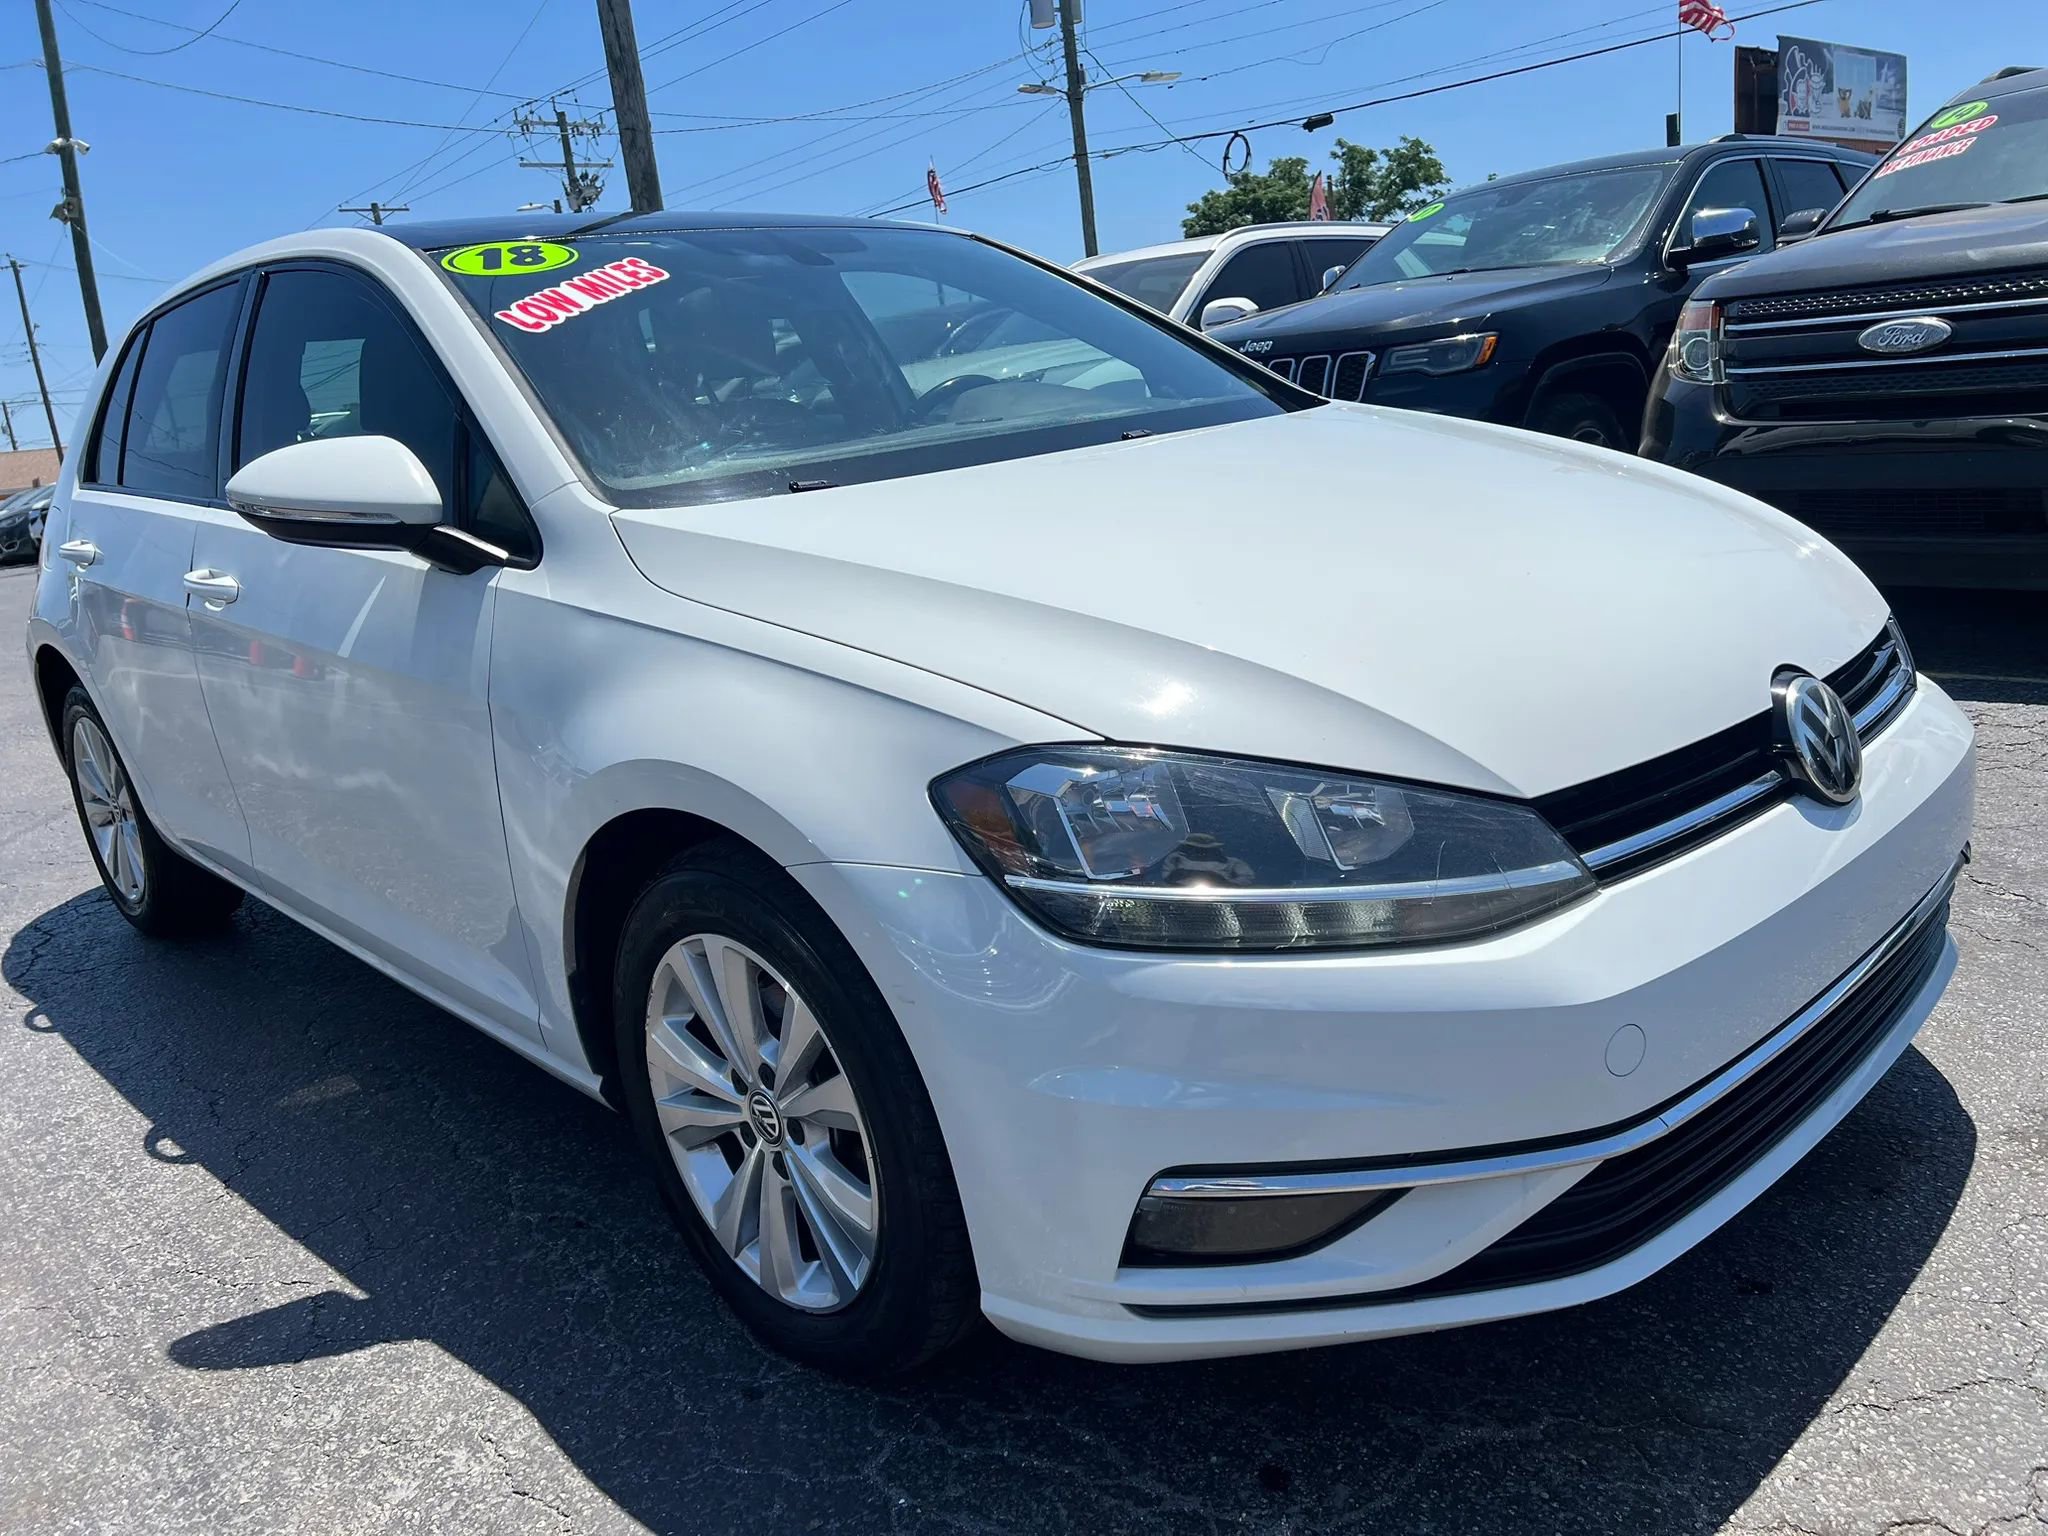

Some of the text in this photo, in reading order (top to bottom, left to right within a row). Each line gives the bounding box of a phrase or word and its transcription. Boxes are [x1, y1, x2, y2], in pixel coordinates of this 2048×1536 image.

[1898, 115, 1997, 155] LOADED
[1901, 137, 1976, 168] FINANCE
[474, 245, 547, 270] 18
[497, 257, 667, 331] LOW MILES
[1239, 339, 1273, 354] Jeep
[1877, 324, 1929, 346] Ford
